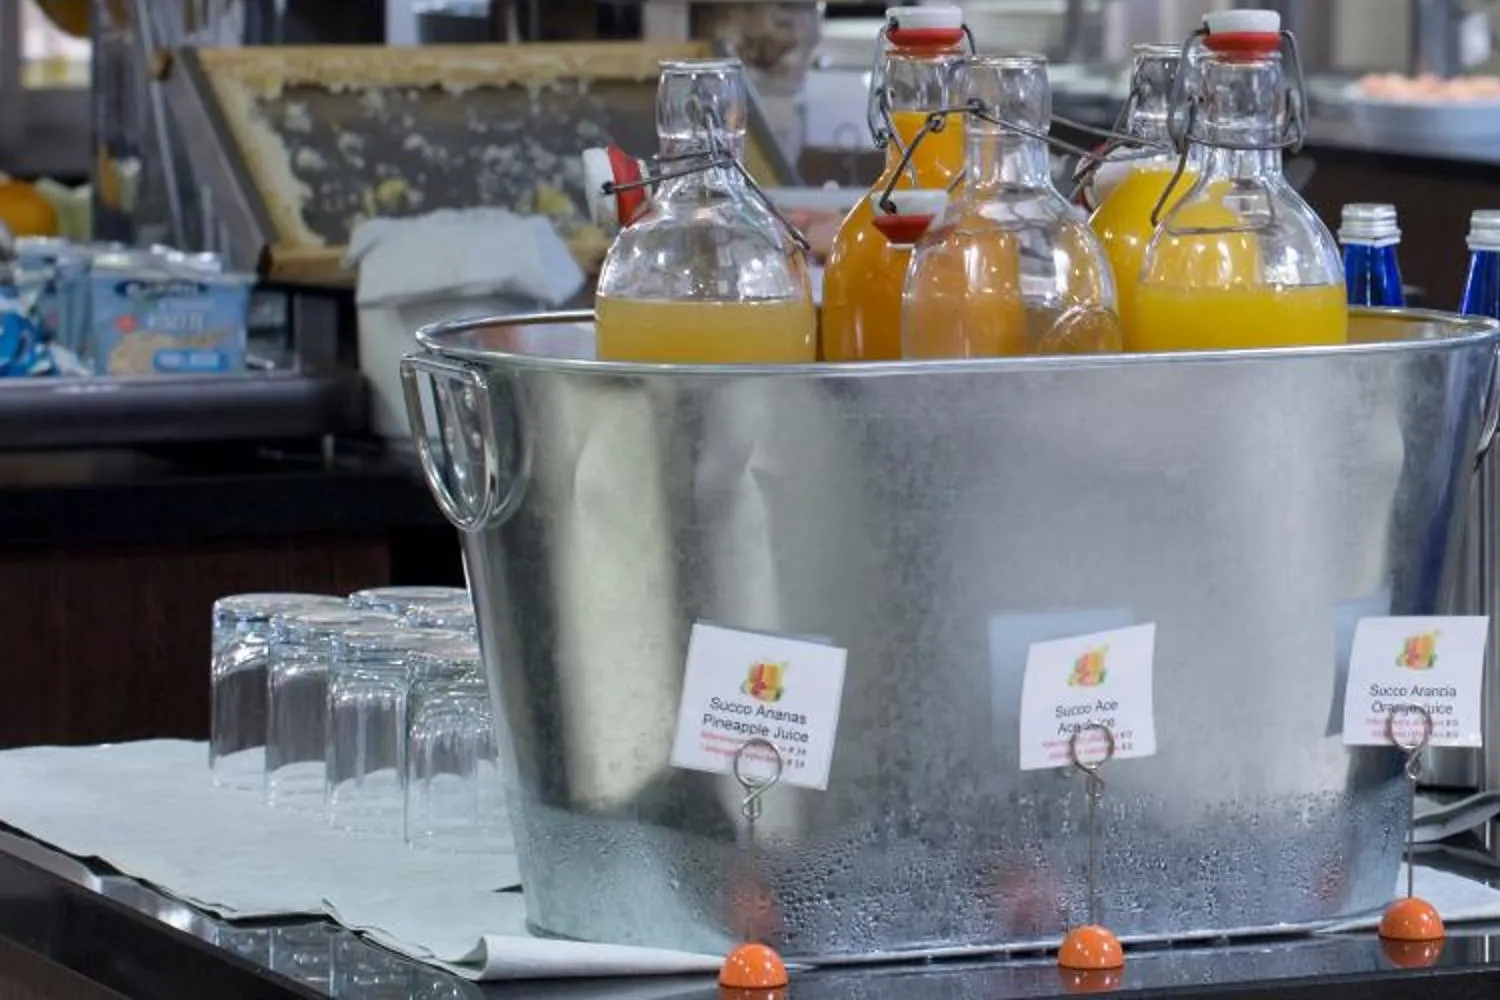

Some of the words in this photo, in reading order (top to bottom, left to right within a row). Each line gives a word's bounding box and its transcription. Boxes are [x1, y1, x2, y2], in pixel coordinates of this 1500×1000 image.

[1370, 683, 1408, 697] Succo
[1410, 684, 1457, 697] Arancia
[709, 695, 752, 715] Succo
[755, 703, 808, 725] Ananas
[1055, 704, 1092, 719] Succo
[703, 712, 770, 736] Pineapple
[773, 726, 810, 744] Juice
